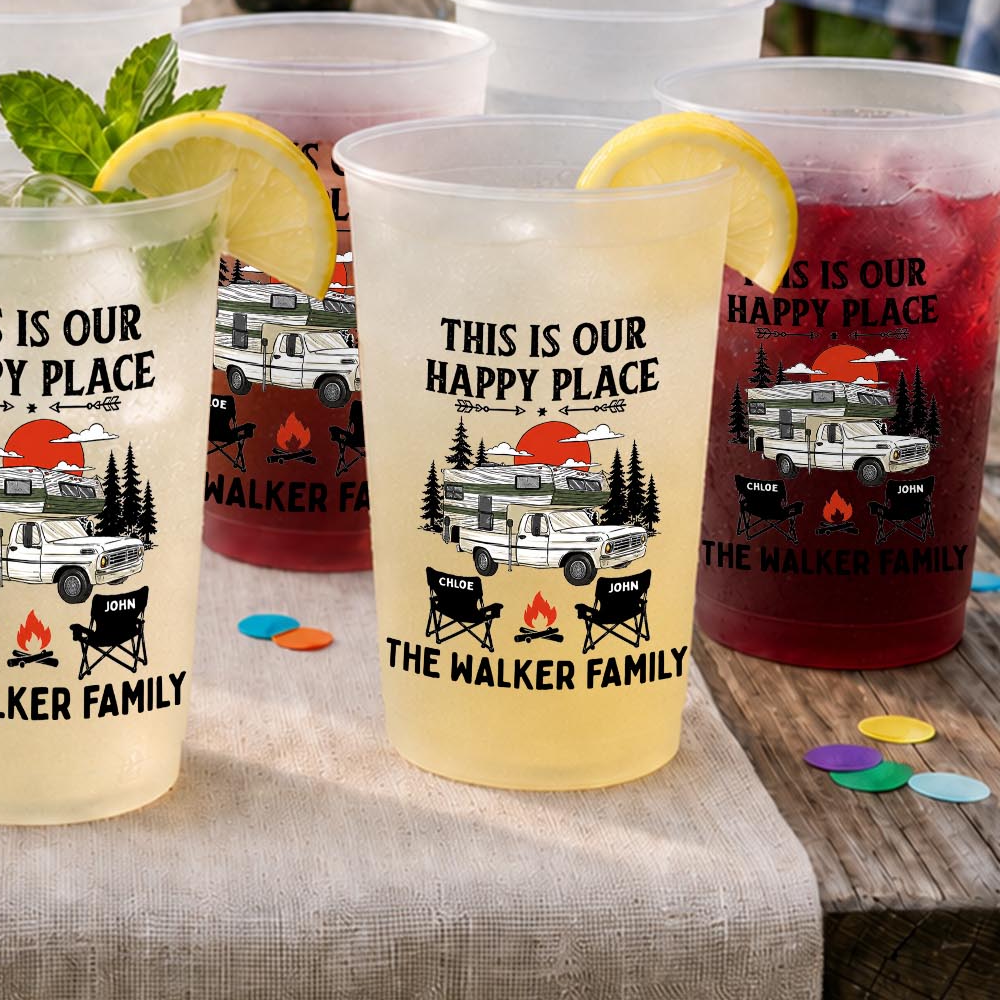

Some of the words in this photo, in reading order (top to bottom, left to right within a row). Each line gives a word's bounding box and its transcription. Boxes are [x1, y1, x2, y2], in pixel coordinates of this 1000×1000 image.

[820, 259, 848, 290] IS
[859, 257, 926, 289] OUR
[17, 310, 49, 347] IS
[64, 304, 141, 346] OUR
[727, 294, 830, 327] HAPPY
[842, 294, 939, 327] PLACE
[441, 318, 516, 356] THIS
[530, 324, 560, 357] IS
[573, 317, 646, 355] OUR
[42, 350, 155, 396] PLACE
[426, 359, 539, 401] HAPPY
[552, 357, 659, 401] PLACE
[204, 472, 328, 512] WALKER
[747, 483, 777, 492] CHLOE
[898, 485, 923, 493] JOHN
[702, 540, 751, 570] THE
[760, 546, 870, 576] WALKER
[879, 544, 968, 575] FAMILY
[439, 575, 476, 590] CHLOE
[609, 581, 638, 593] JOHN
[105, 598, 135, 612] JOHN
[387, 637, 442, 678] THE
[451, 652, 574, 690] WALKER
[586, 646, 687, 688] FAMILY
[83, 671, 186, 719] FAMILY
